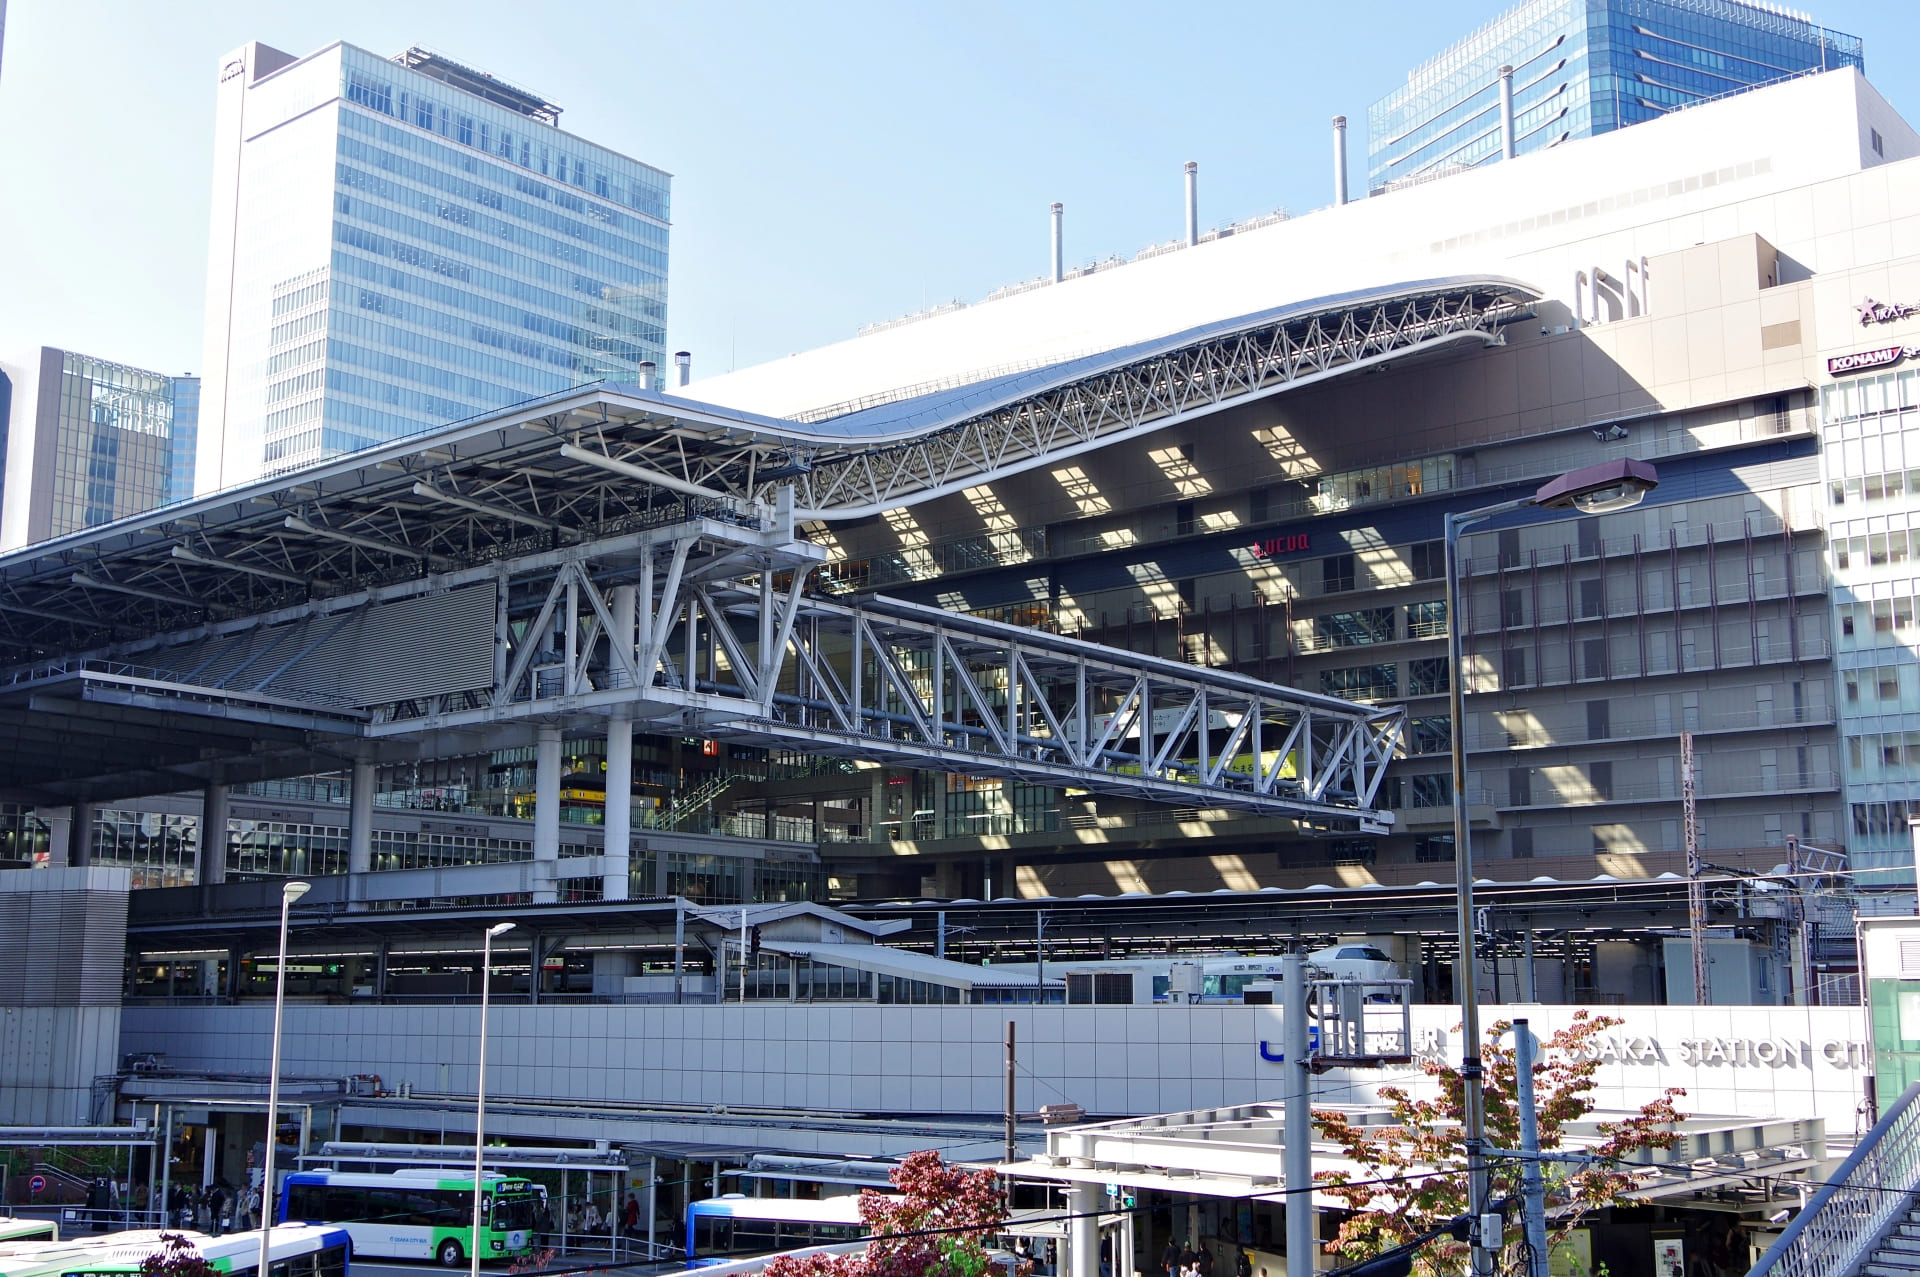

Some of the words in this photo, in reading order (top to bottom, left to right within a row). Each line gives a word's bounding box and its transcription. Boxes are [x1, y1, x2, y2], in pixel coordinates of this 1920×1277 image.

[1832, 348, 1893, 370] KONAMI
[1557, 1036, 1661, 1061] SAKA
[1677, 1037, 1803, 1063] STATION
